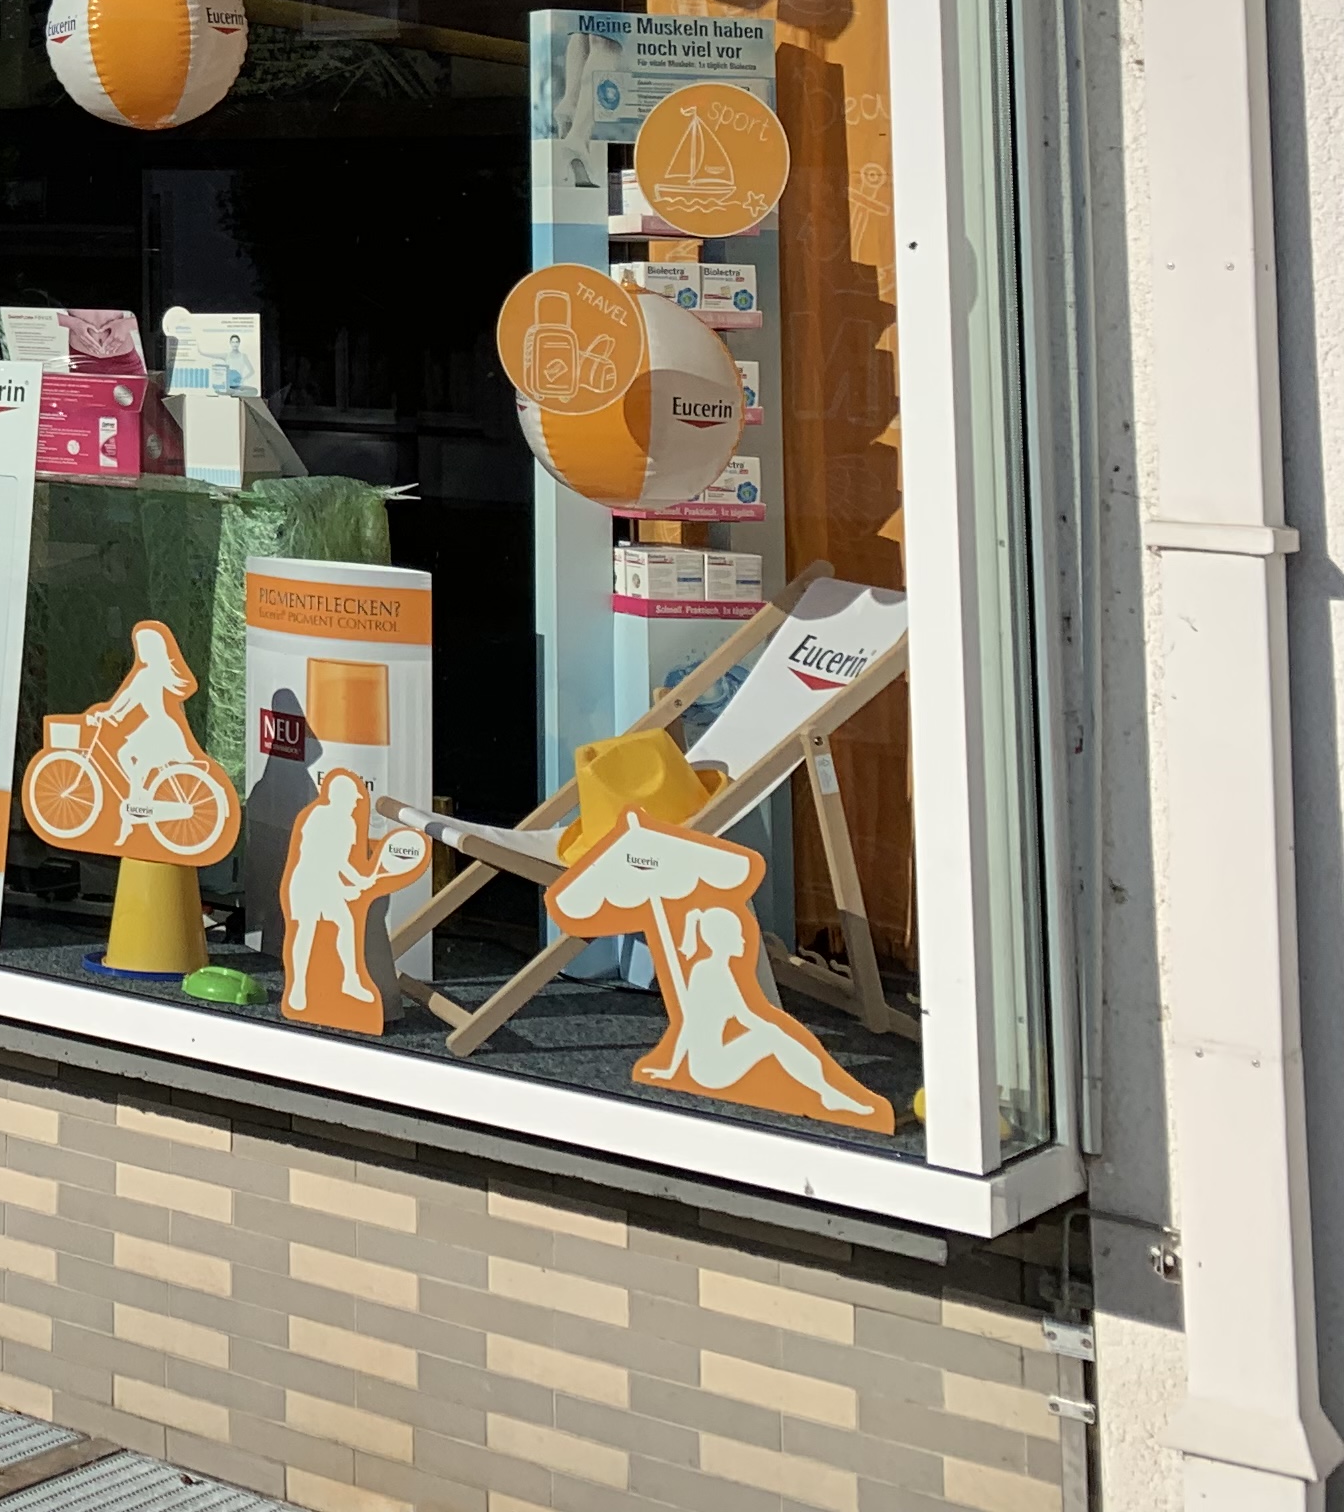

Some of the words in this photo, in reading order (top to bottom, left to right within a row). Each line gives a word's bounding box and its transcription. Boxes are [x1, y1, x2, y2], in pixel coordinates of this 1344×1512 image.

[47, 16, 76, 36] Eucerin
[206, 7, 244, 26] Eucerin
[579, 15, 632, 34] Meine
[637, 17, 709, 37] Muskeln
[713, 20, 764, 40] haben
[637, 40, 677, 57] noch
[682, 41, 711, 58] viel
[716, 44, 742, 59] vor
[707, 101, 773, 142] sport
[647, 266, 685, 275] Biolectra
[703, 268, 741, 277] Biolectra
[575, 281, 628, 327] TRAVEL
[672, 396, 733, 419] Eucerin
[259, 587, 401, 618] PIGMENTFLECKEN?
[287, 613, 333, 628] PIGMENT
[337, 617, 400, 633] CONTROL
[788, 634, 868, 679] Eucerin
[264, 714, 300, 745] NEU
[126, 804, 154, 815] Eucerin
[388, 844, 420, 856] Eucerin
[626, 853, 659, 867] Eucerin
